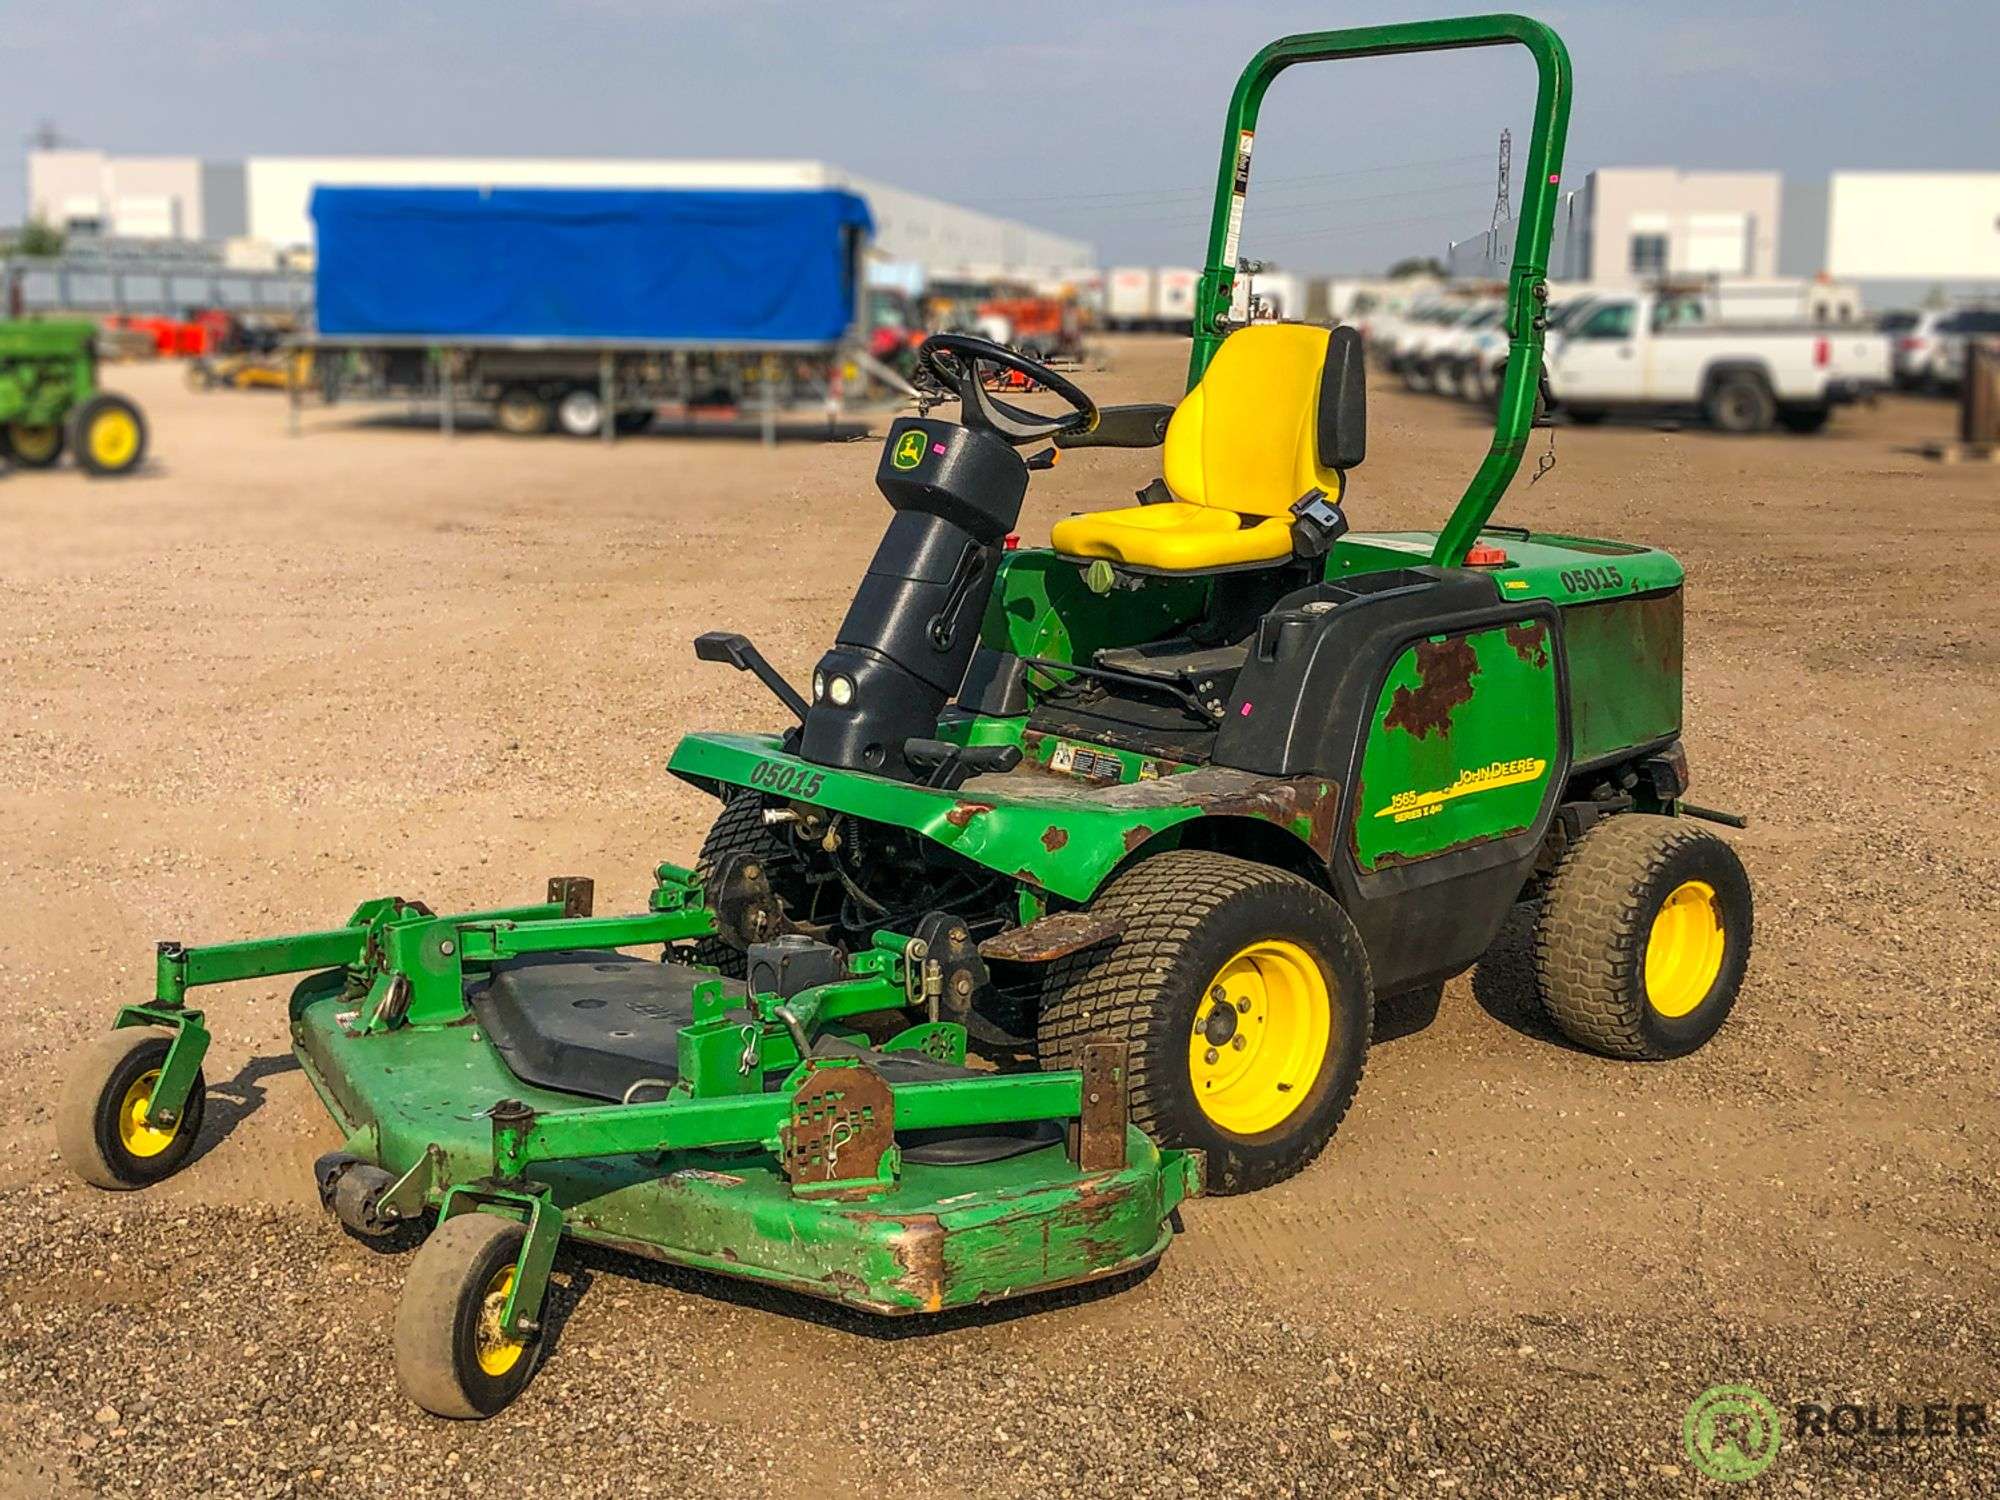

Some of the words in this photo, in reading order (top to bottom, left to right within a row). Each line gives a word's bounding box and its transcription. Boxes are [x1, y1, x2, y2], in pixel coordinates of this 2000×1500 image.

[1560, 565, 1624, 594] 05015
[749, 760, 826, 799] 05015
[1454, 766, 1490, 786] JOHN
[1491, 757, 1534, 777] DEERE
[1391, 790, 1416, 810] 1565
